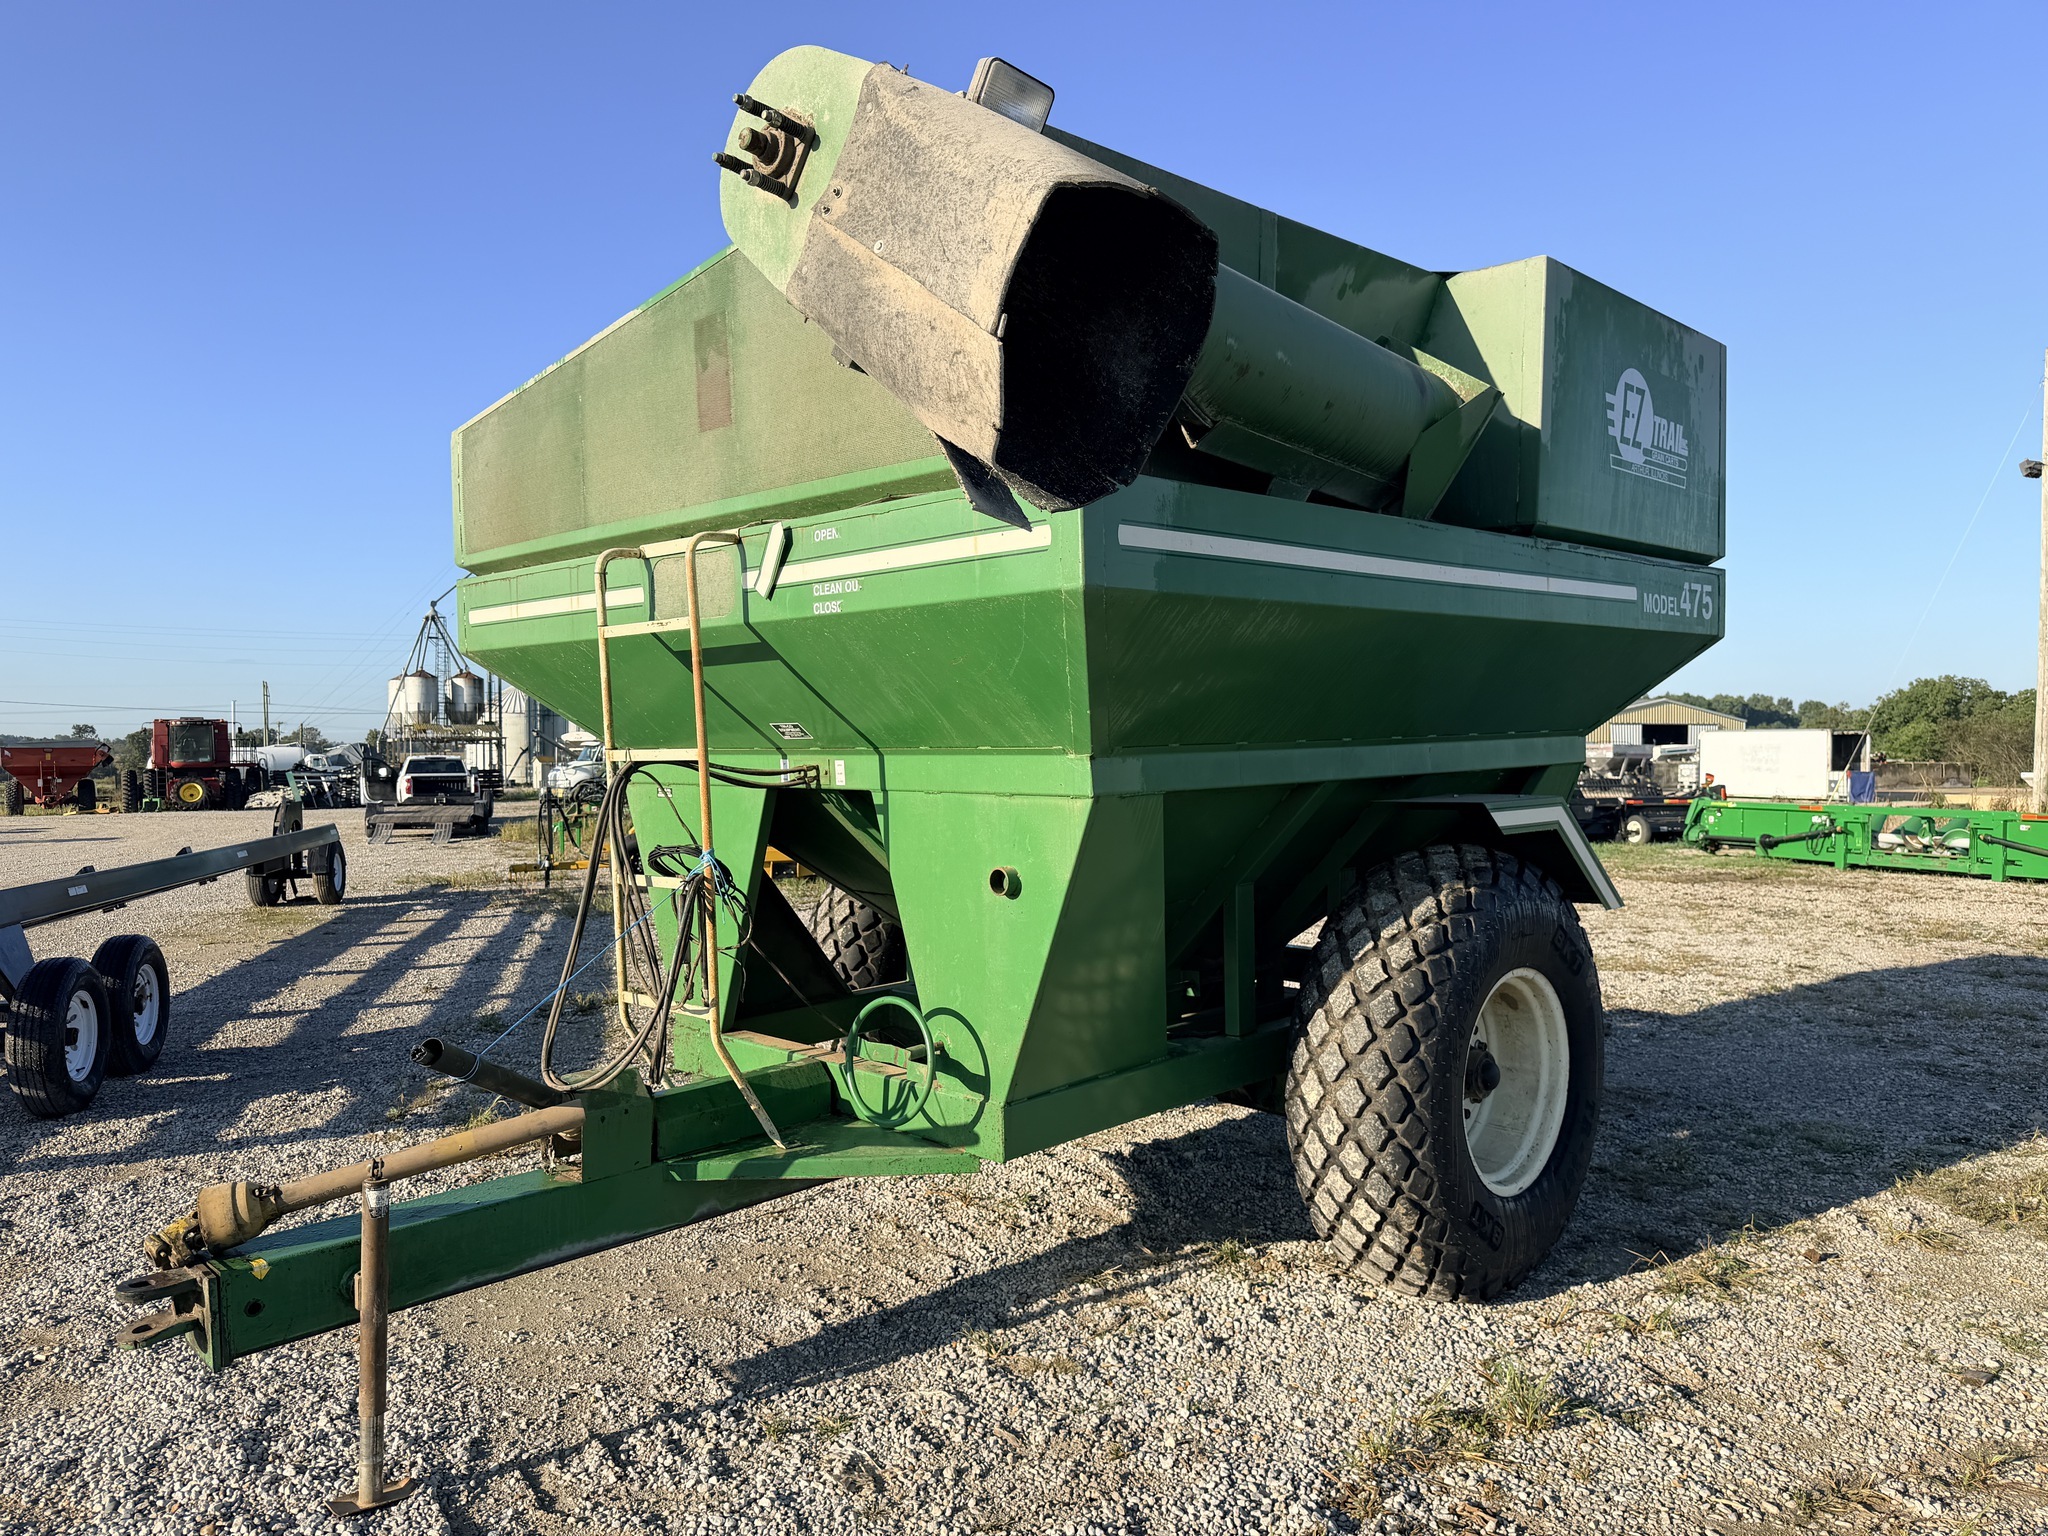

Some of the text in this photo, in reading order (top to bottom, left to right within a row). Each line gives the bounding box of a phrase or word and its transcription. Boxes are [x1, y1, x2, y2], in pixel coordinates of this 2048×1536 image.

[1653, 415, 1688, 457] TRAIL
[813, 578, 862, 596] CLEAN OU
[1643, 581, 1713, 620] MODEL 475
